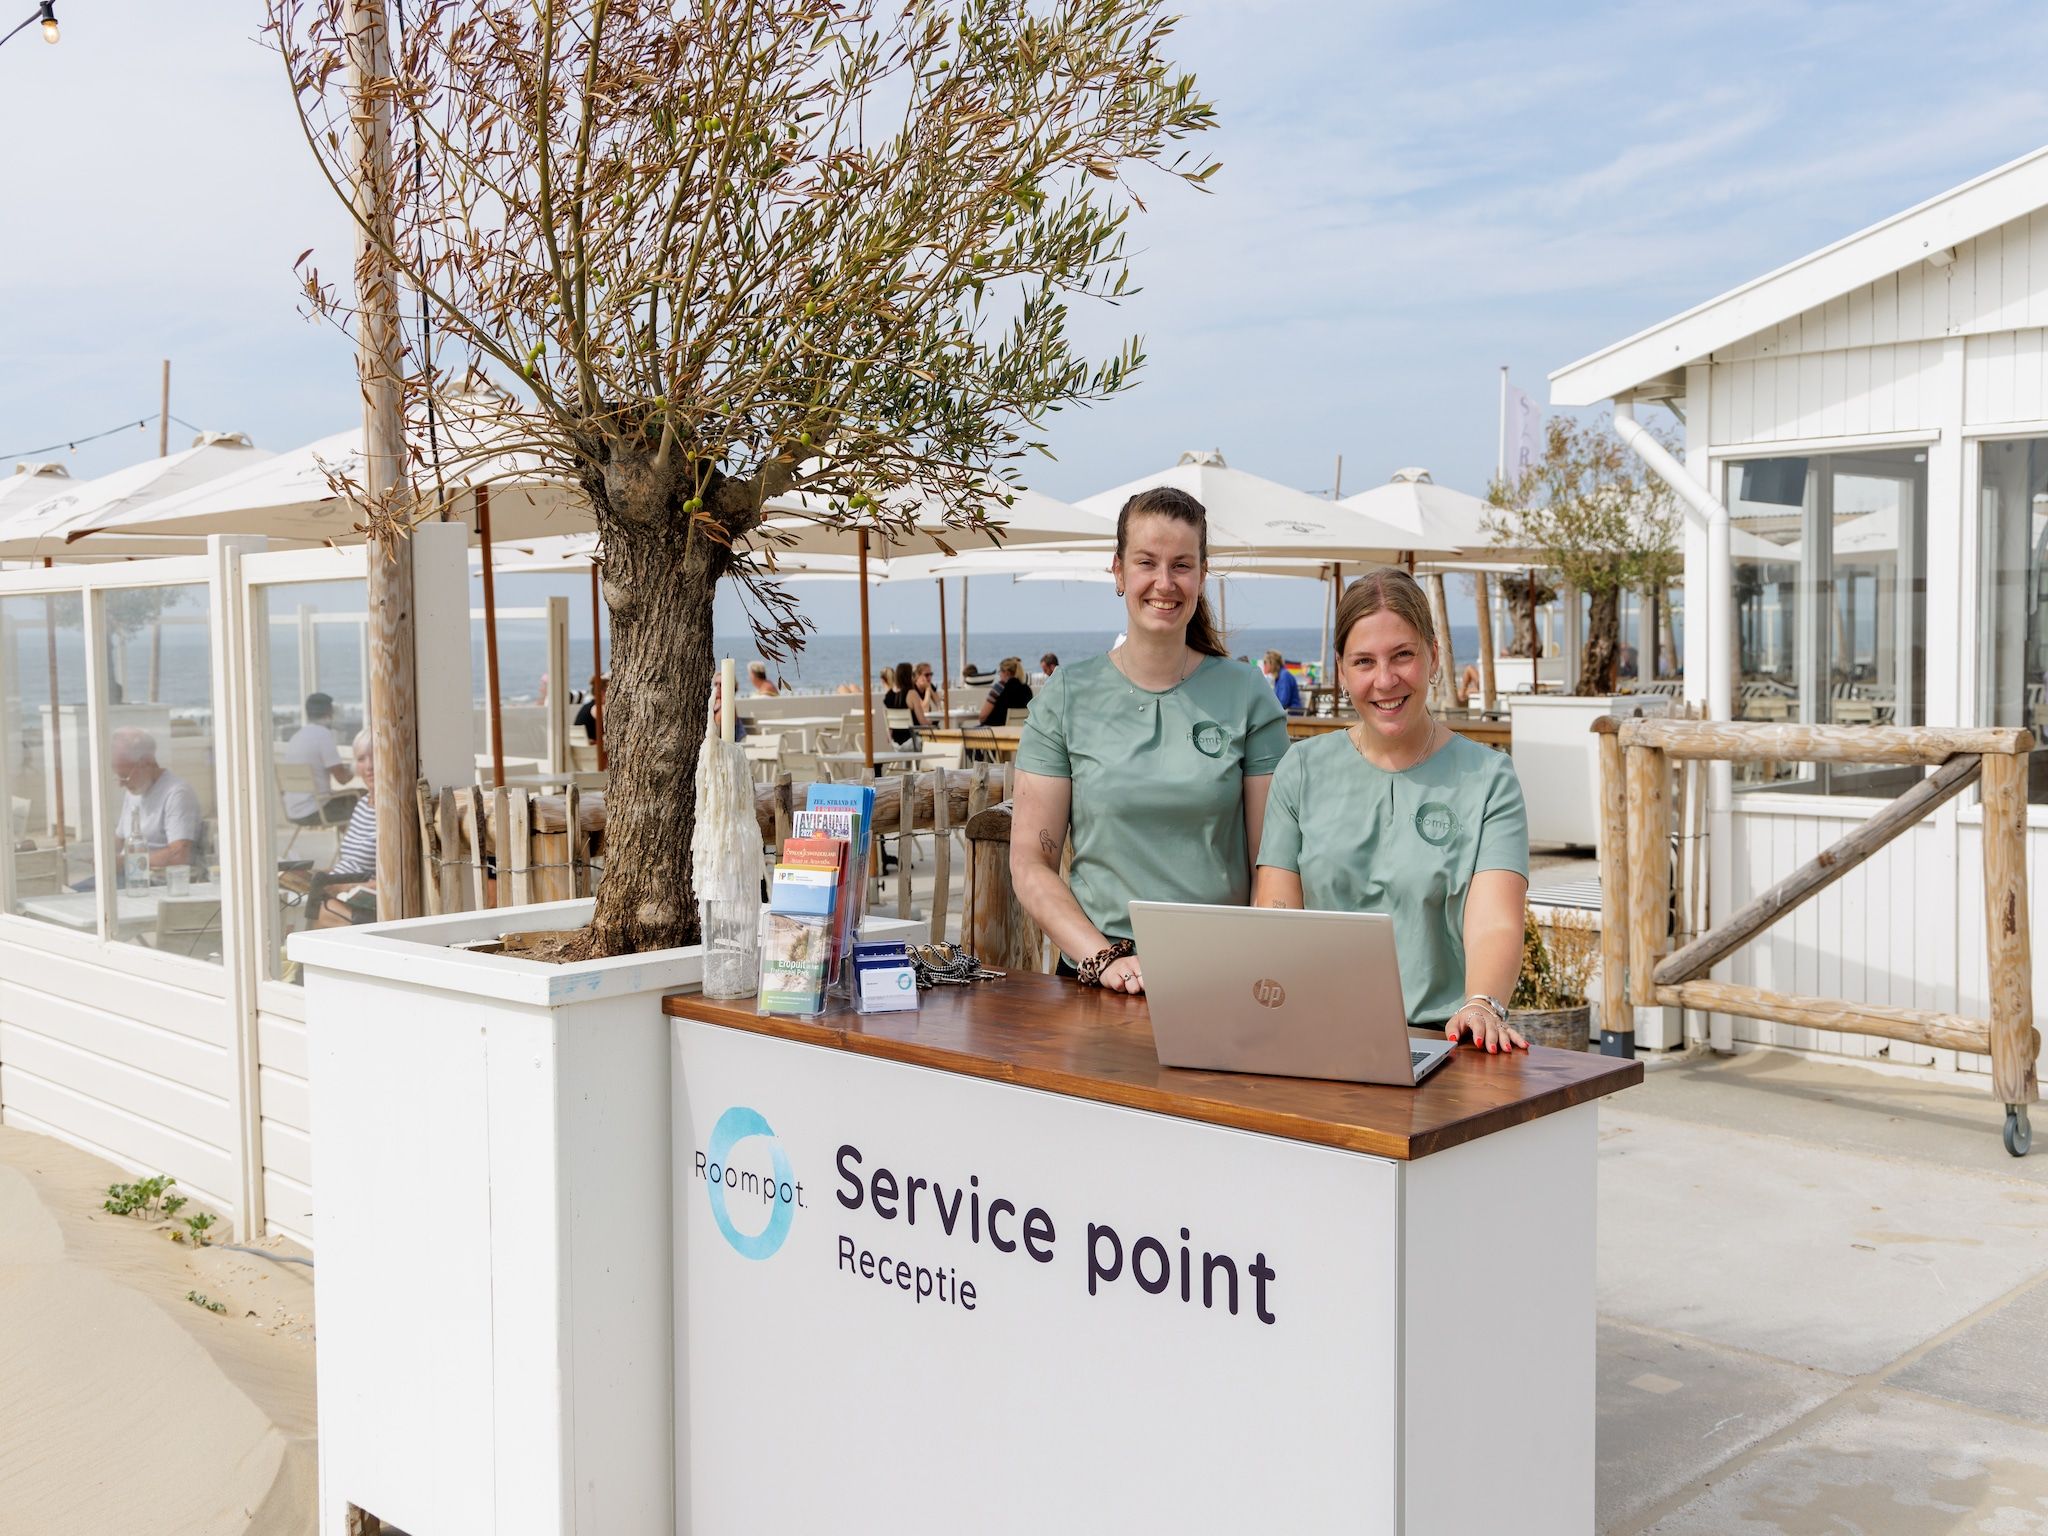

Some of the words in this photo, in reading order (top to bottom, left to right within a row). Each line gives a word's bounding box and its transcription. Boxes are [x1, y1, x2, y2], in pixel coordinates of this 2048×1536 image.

[1186, 731, 1233, 746] Roompt
[800, 812, 850, 831] AVIFAUNA
[778, 960, 806, 970] Eropuit
[797, 969, 810, 977] Park
[1258, 978, 1281, 1008] hp
[836, 1145, 1055, 1264] Service
[1087, 1222, 1276, 1325] point
[838, 1234, 977, 1311] Receptie
